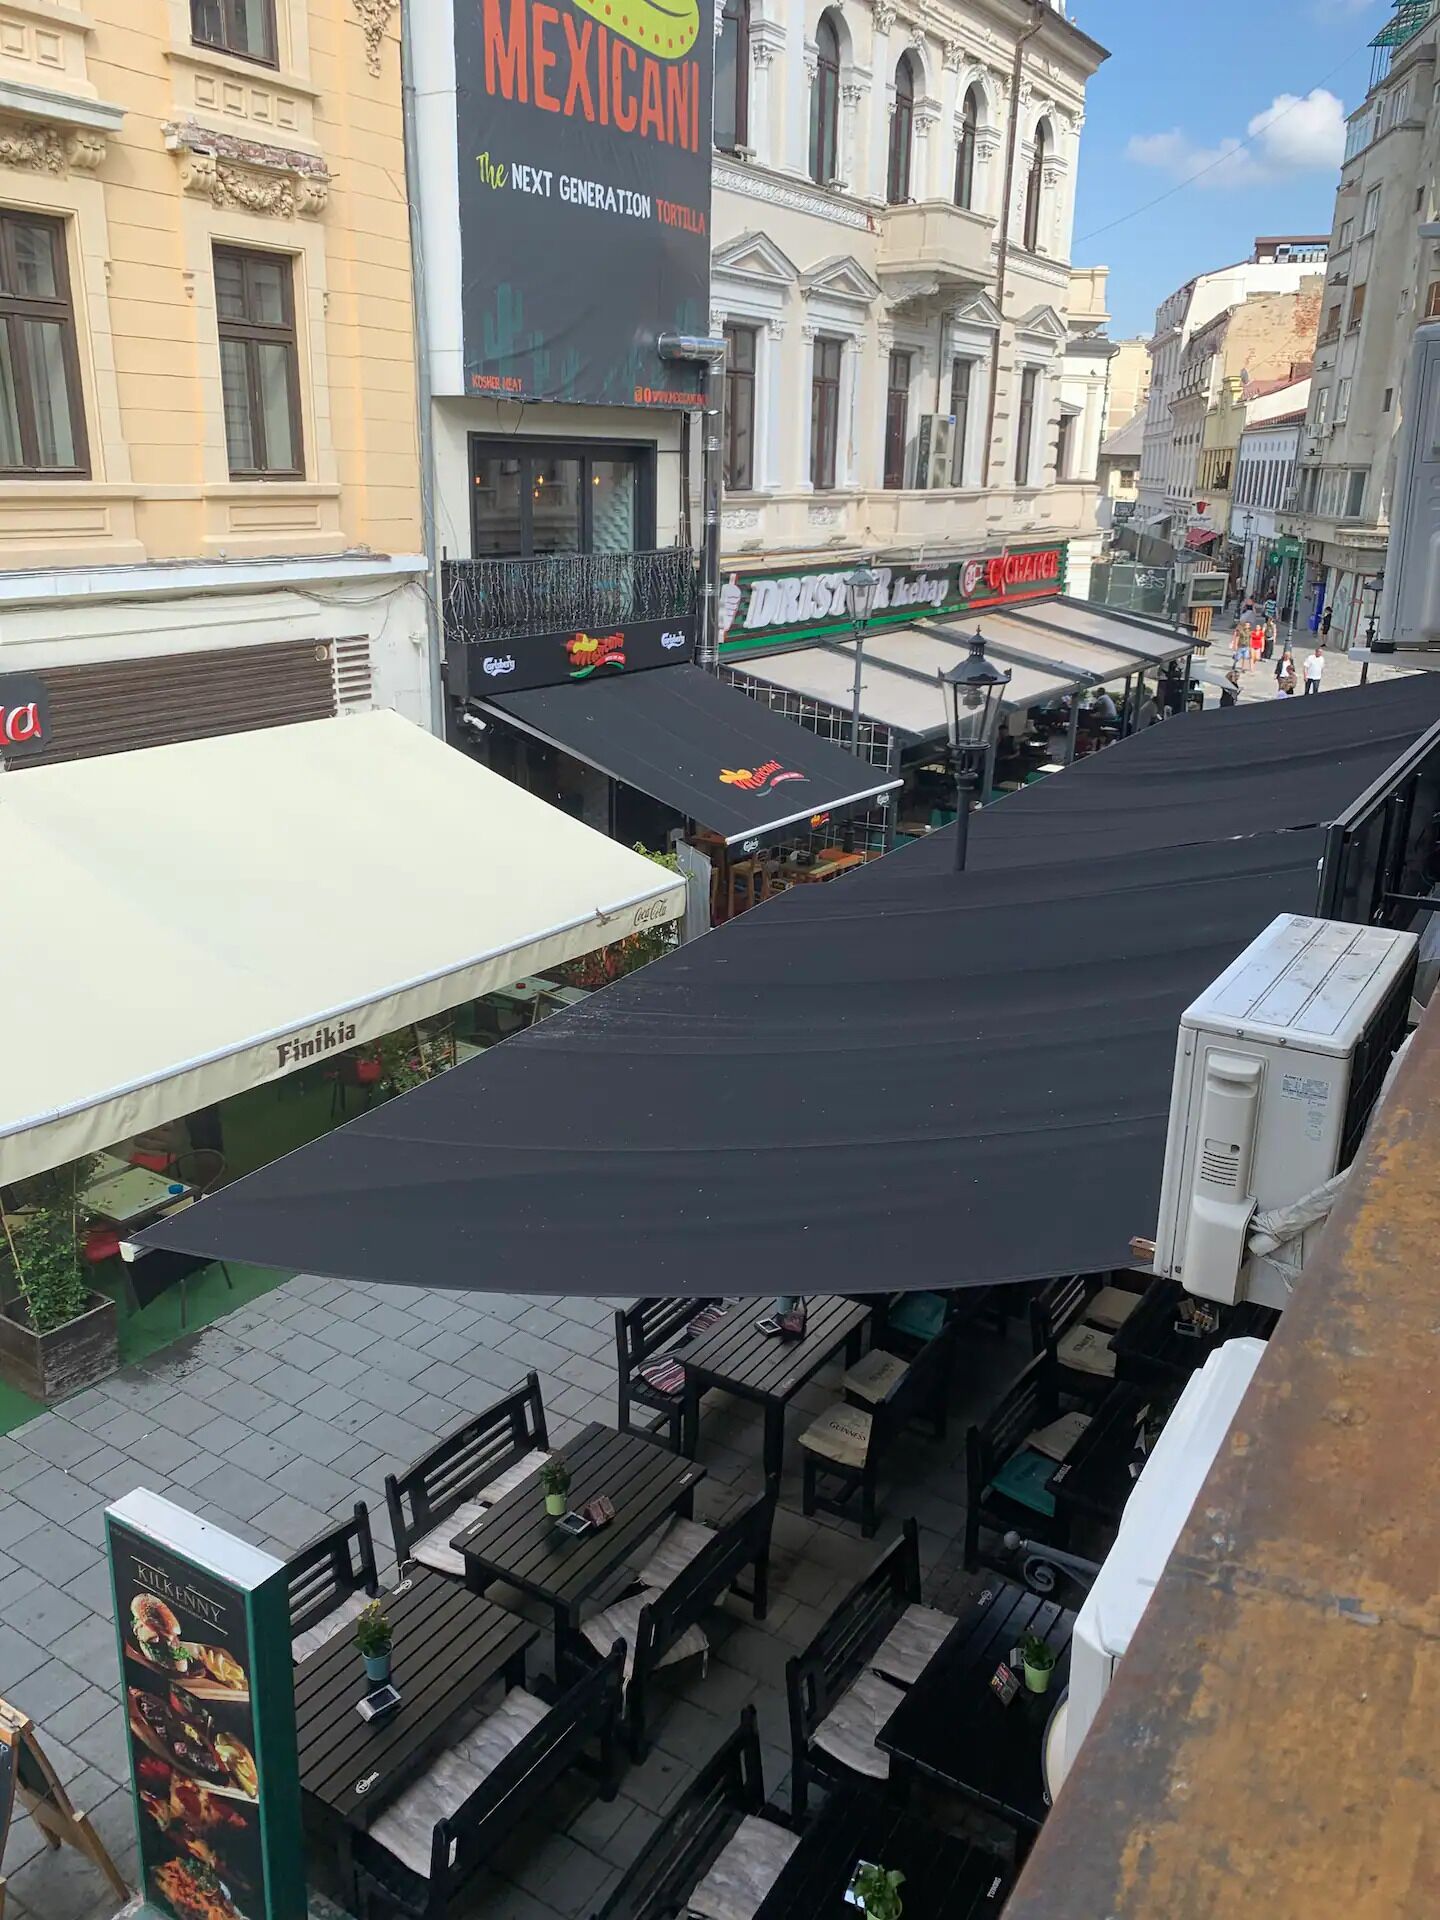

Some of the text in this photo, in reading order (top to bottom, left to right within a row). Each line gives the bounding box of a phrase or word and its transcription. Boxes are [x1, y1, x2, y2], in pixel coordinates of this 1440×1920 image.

[483, 0, 700, 153] MEXICANI
[476, 151, 706, 236] The NEXT GENERATION TORTILLA
[743, 567, 950, 629] DRISTR kebap
[483, 654, 516, 677] Carlsberg
[276, 1021, 356, 1069] Finikia
[137, 1564, 221, 1623] KILKENNY
